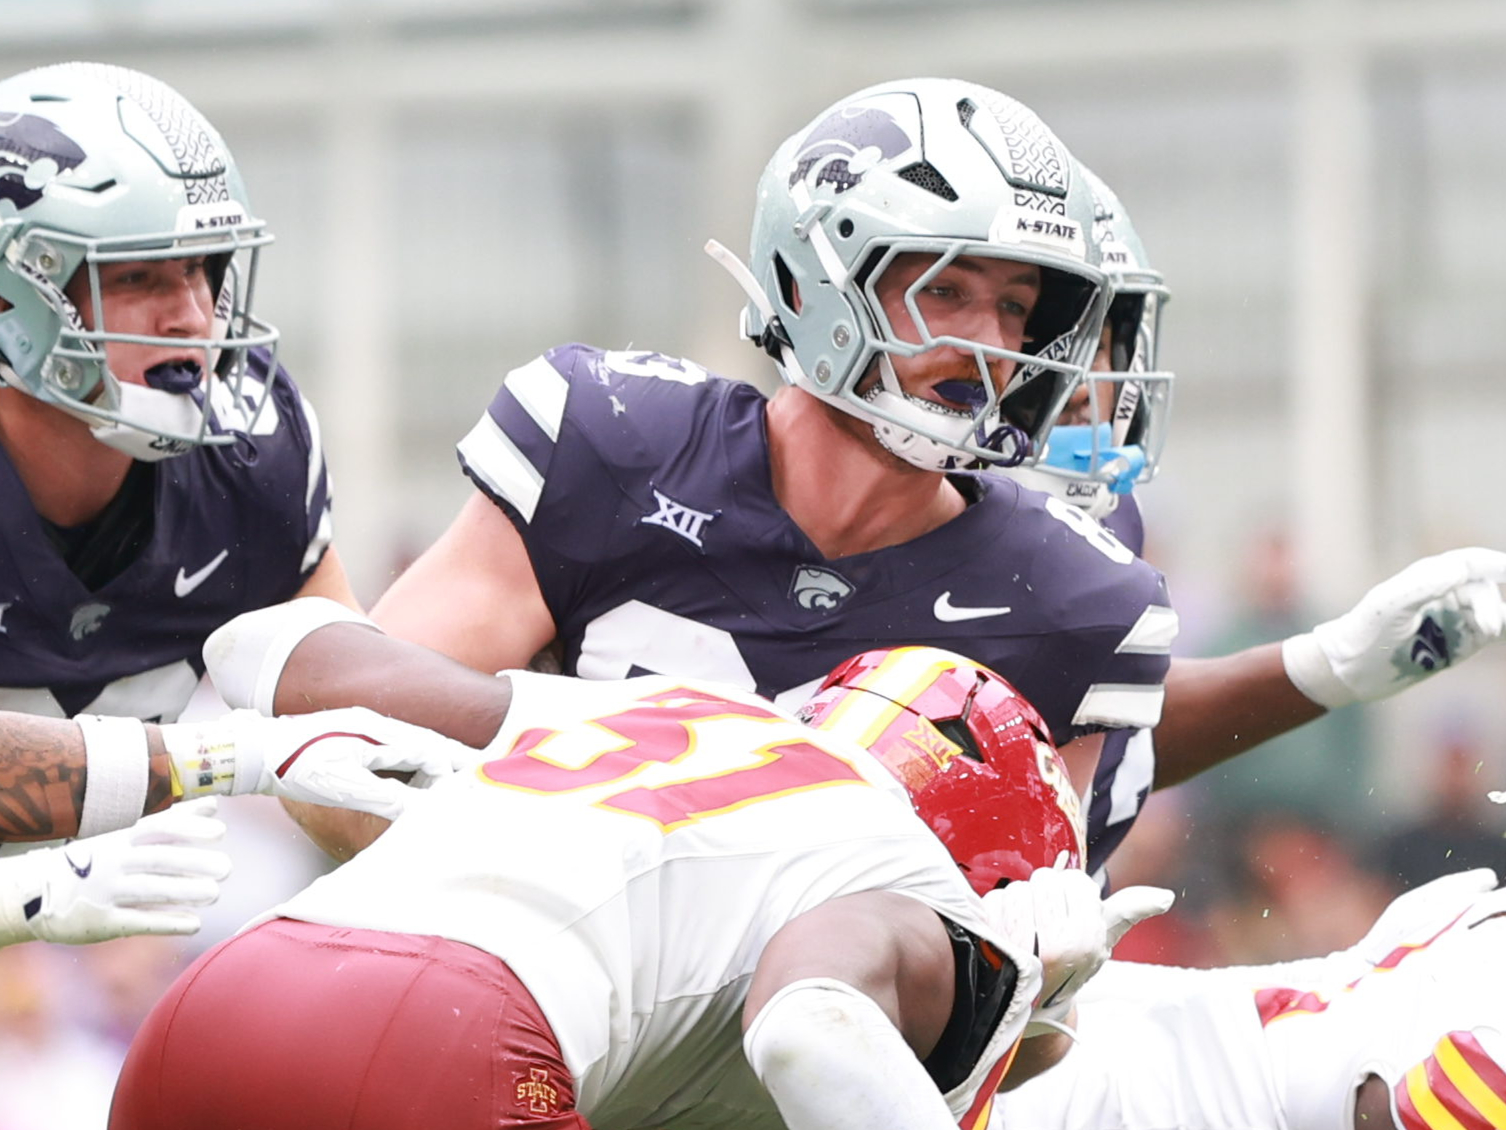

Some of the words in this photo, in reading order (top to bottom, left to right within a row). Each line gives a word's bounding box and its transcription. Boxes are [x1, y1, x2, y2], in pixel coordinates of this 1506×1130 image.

[1016, 218, 1077, 240] K-STATE
[1021, 332, 1076, 383] K-TAT
[641, 489, 715, 548] XII
[517, 1081, 557, 1105] STATE
